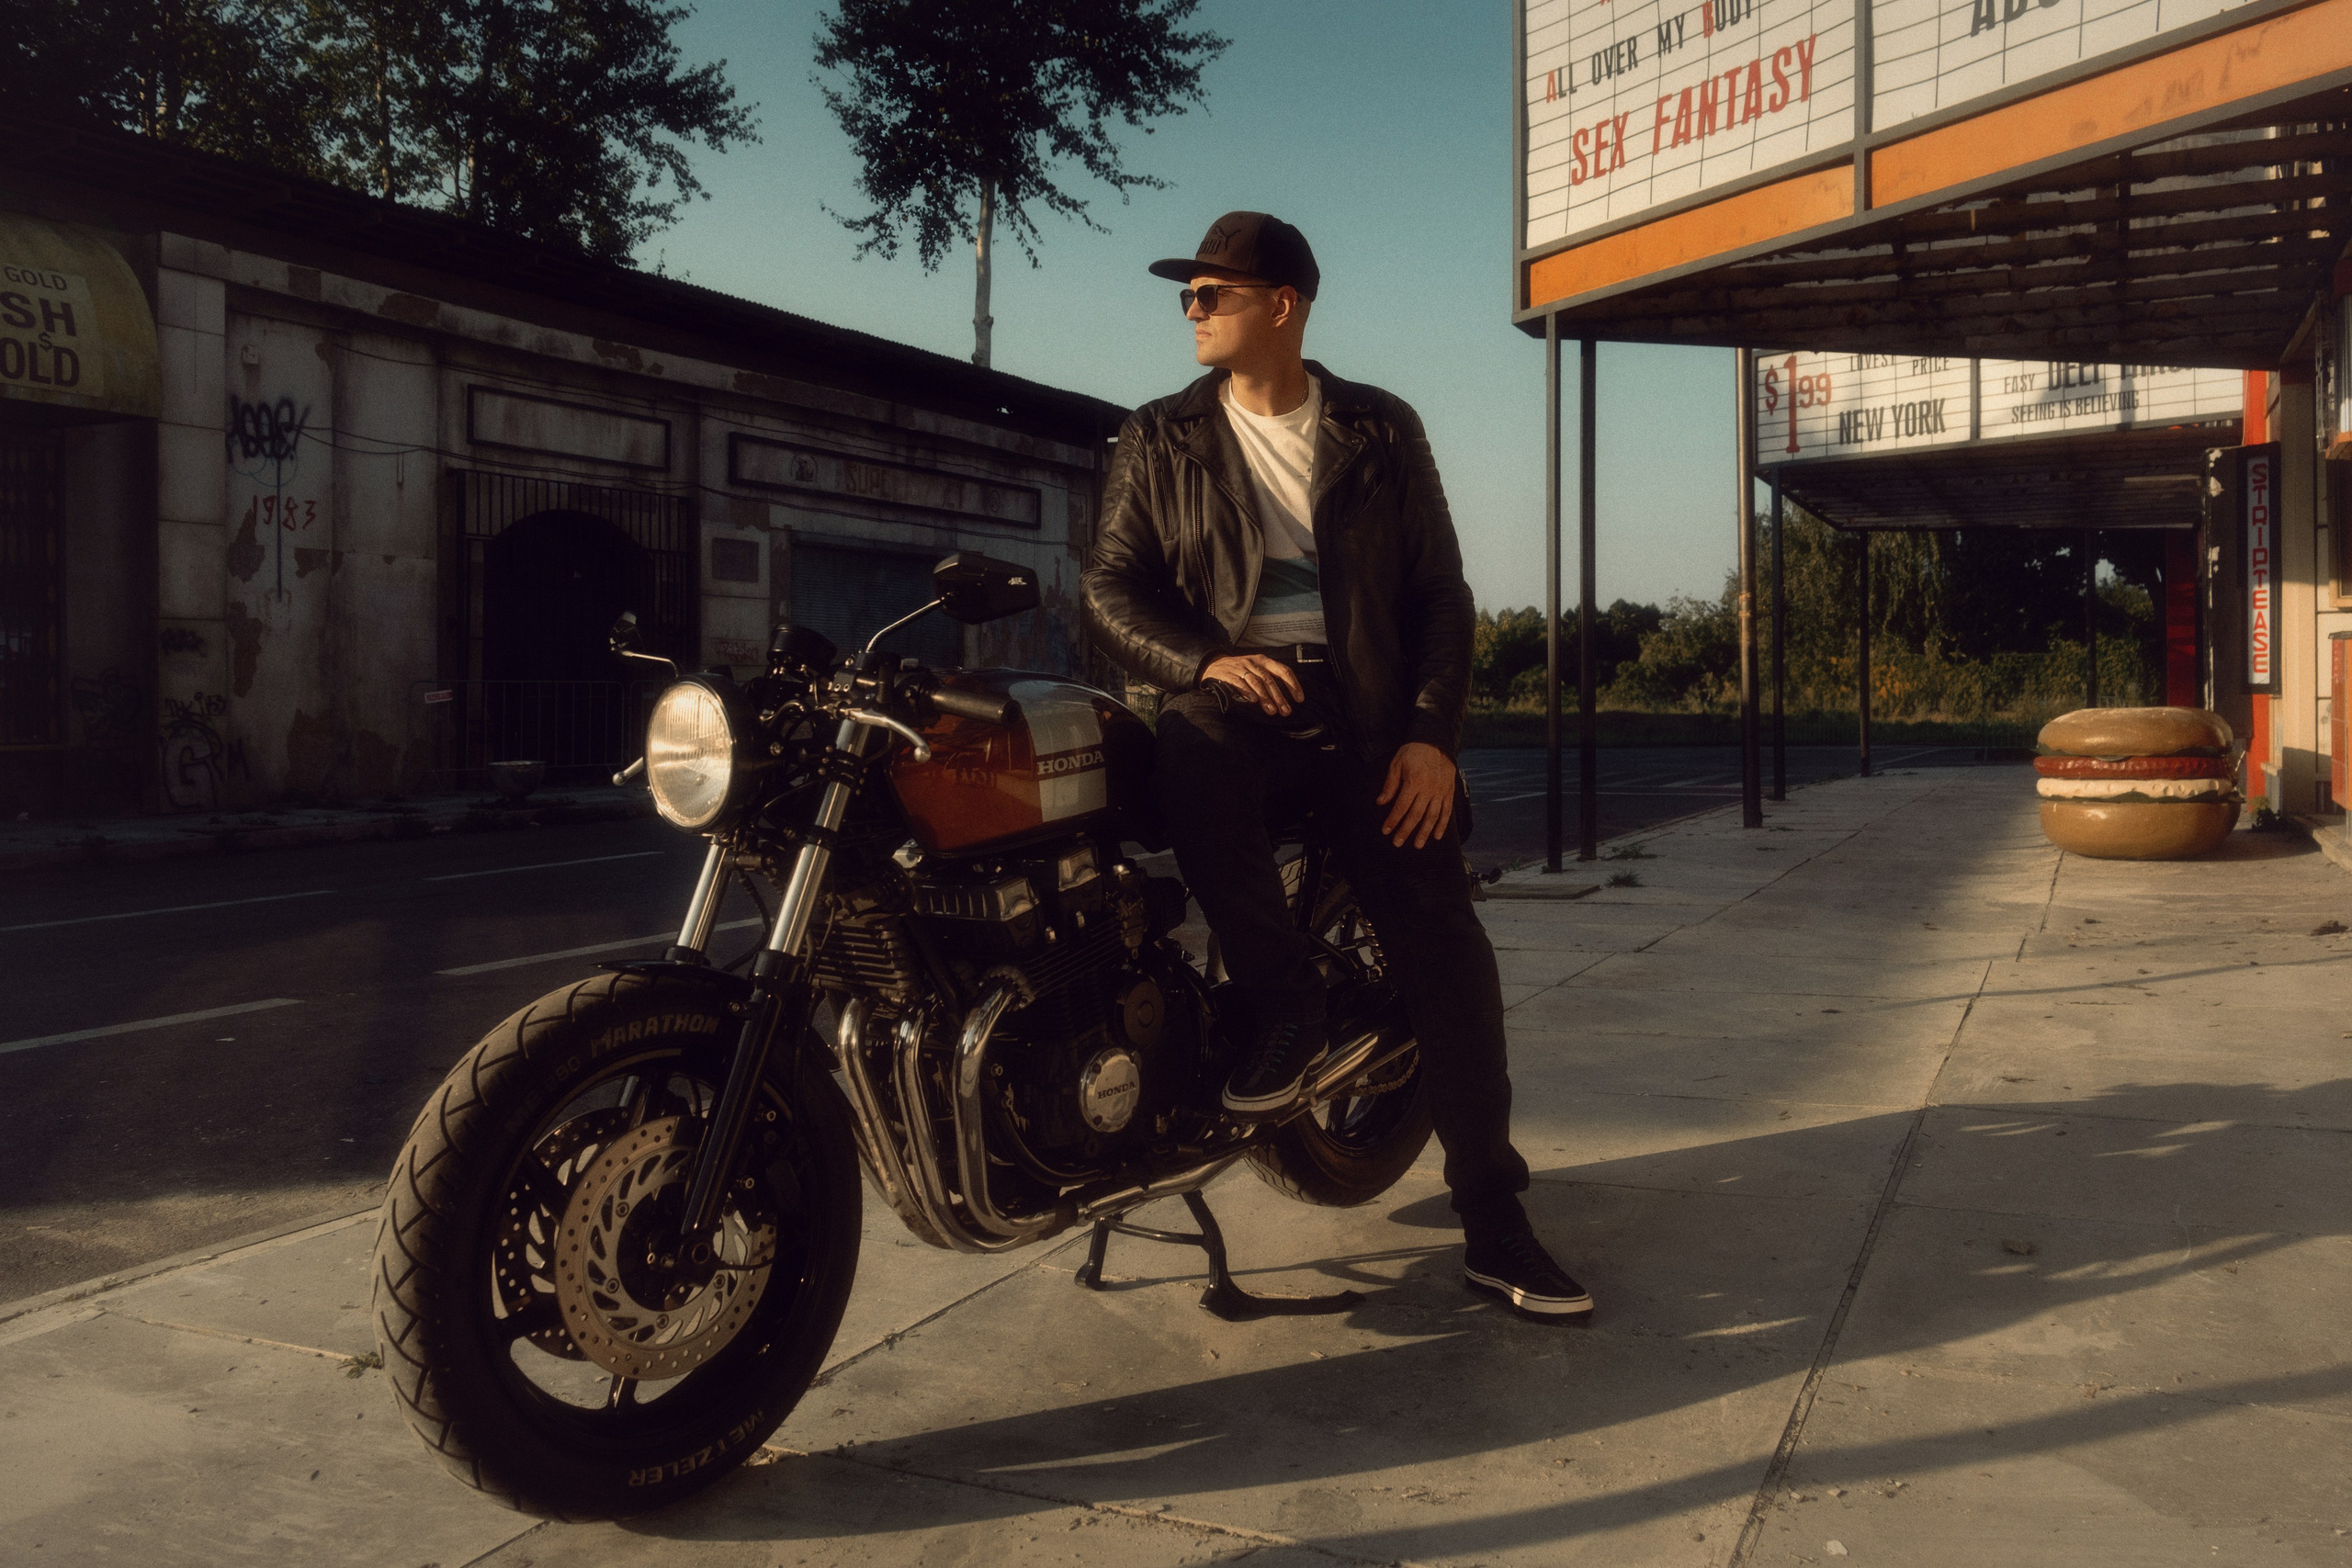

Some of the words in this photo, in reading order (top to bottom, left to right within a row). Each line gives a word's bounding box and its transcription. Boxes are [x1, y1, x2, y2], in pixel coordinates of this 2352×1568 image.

[1545, 62, 1577, 104] ALL
[1591, 36, 1639, 86] OVER
[1657, 13, 1686, 59] MY
[1570, 111, 1630, 186] SEX
[1653, 33, 1817, 155] FANTASY
[4, 266, 68, 291] GOLD
[1912, 356, 1950, 377] PRICE
[2004, 373, 2035, 394] EASY
[1839, 406, 1884, 445] NEW
[1892, 398, 1946, 439] YORK
[2011, 401, 2055, 423] SEEING
[2060, 400, 2072, 418] IS
[2075, 390, 2140, 416] BELIEVING
[252, 494, 317, 532] 1983
[1036, 750, 1105, 774] HONDA
[590, 1013, 720, 1058] MARATHON
[1097, 1081, 1136, 1100] HONDA
[628, 1407, 765, 1487] METZELER
